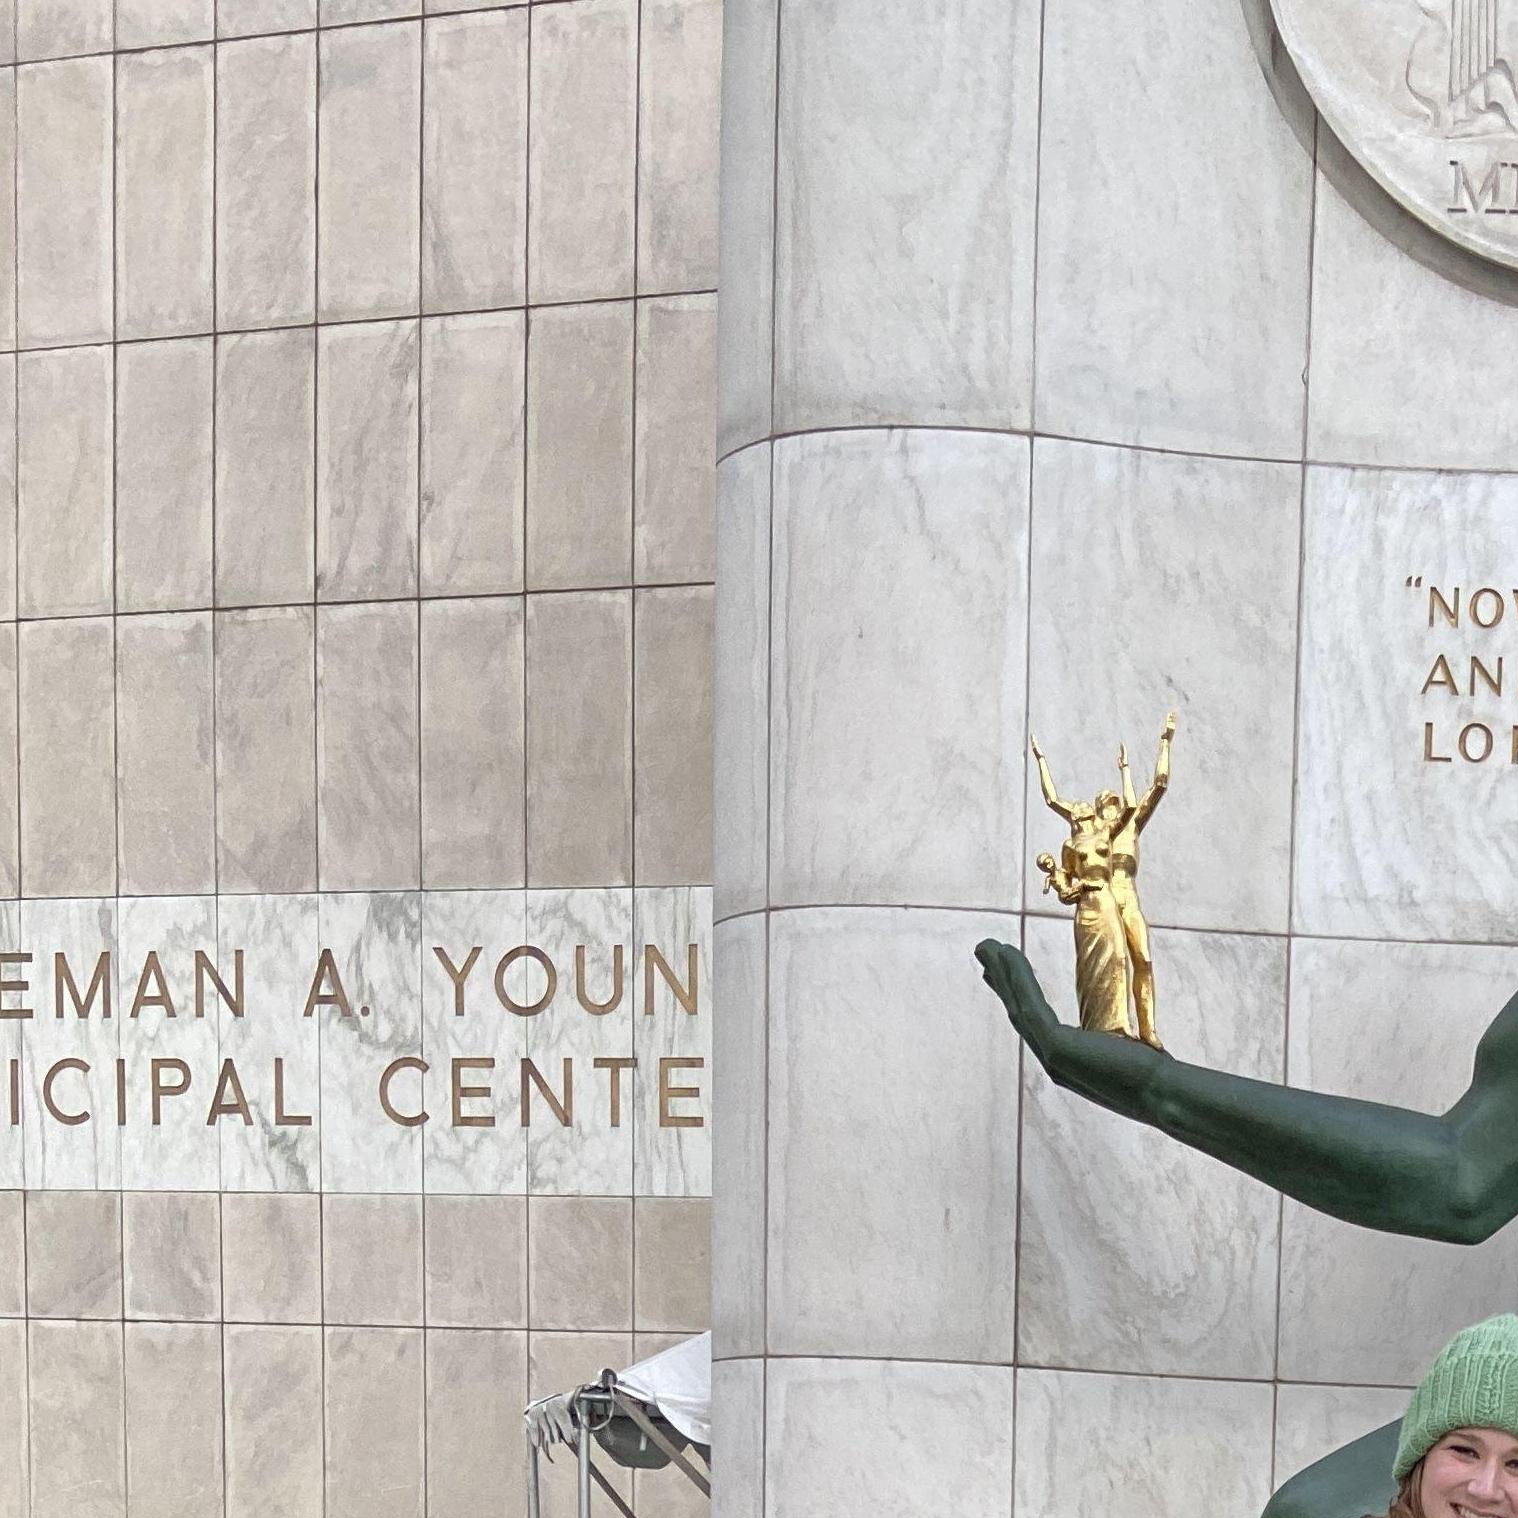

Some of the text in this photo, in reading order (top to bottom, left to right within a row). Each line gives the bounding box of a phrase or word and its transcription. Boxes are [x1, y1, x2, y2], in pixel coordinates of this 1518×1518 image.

[0, 944, 699, 1019] EMAN A. YOUN
[9, 1057, 706, 1128] ICIPAL CENTE
